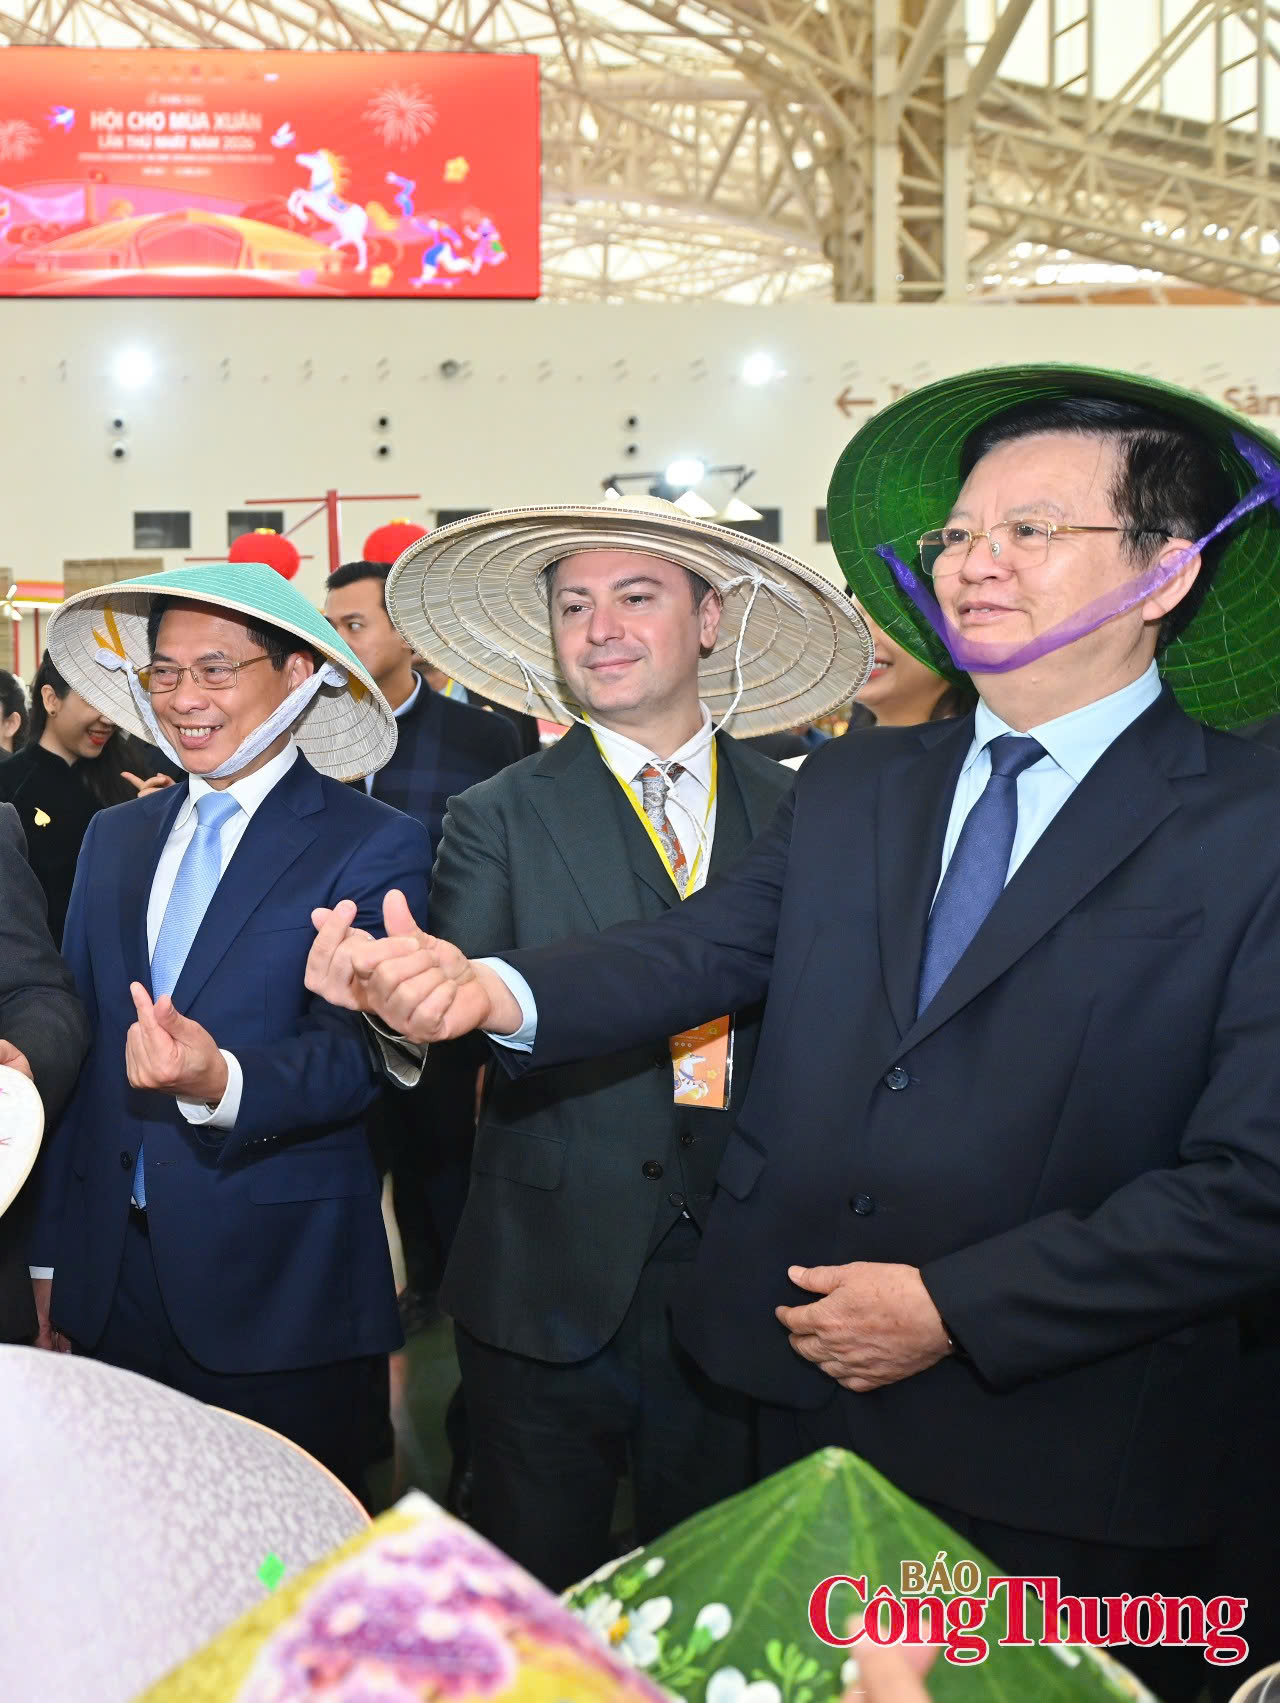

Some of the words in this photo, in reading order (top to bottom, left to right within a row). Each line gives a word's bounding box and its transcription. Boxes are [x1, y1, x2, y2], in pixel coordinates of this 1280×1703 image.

[90, 107, 124, 133] HỘI
[127, 110, 166, 133] CHỢ
[169, 109, 210, 132] MÙA
[213, 107, 262, 132] XUÂN
